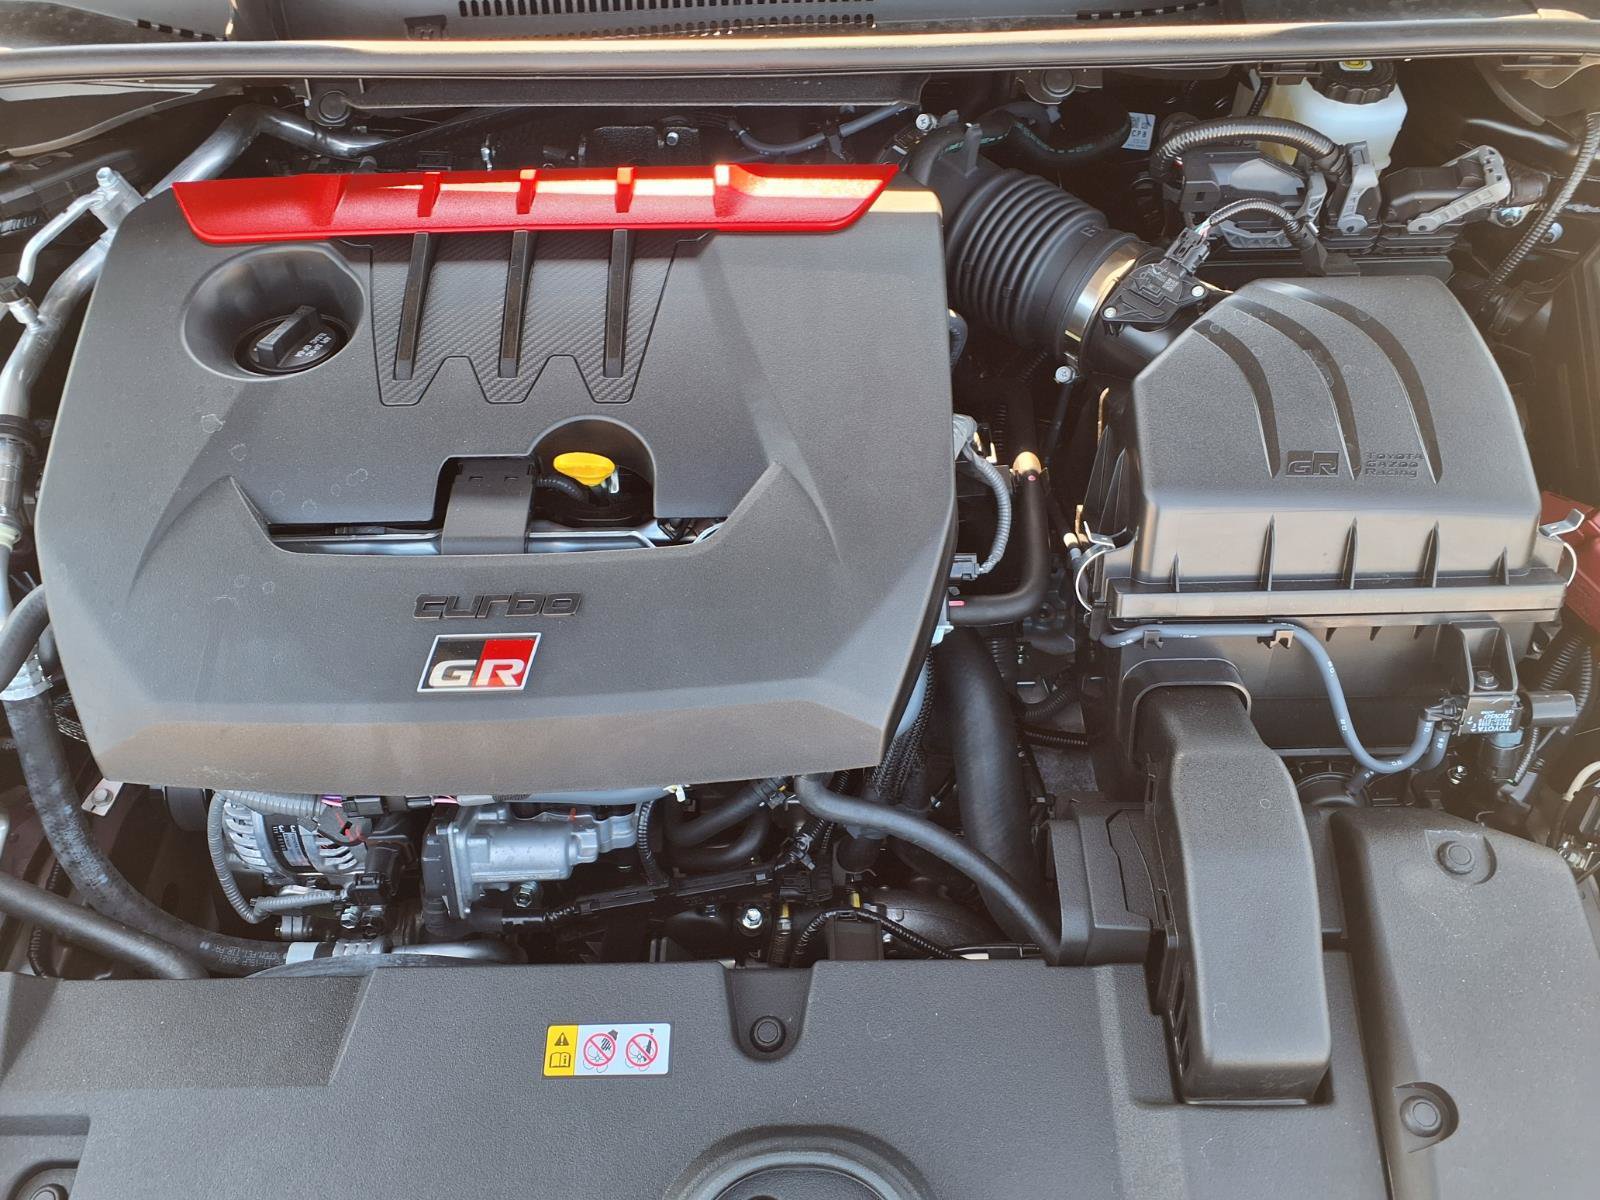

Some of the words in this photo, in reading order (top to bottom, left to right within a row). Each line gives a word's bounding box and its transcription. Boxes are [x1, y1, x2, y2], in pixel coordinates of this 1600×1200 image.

[1364, 460, 1419, 468] GAZOO
[1365, 452, 1424, 460] TOYOTA
[413, 592, 582, 619] turbo
[428, 658, 525, 688] GR
